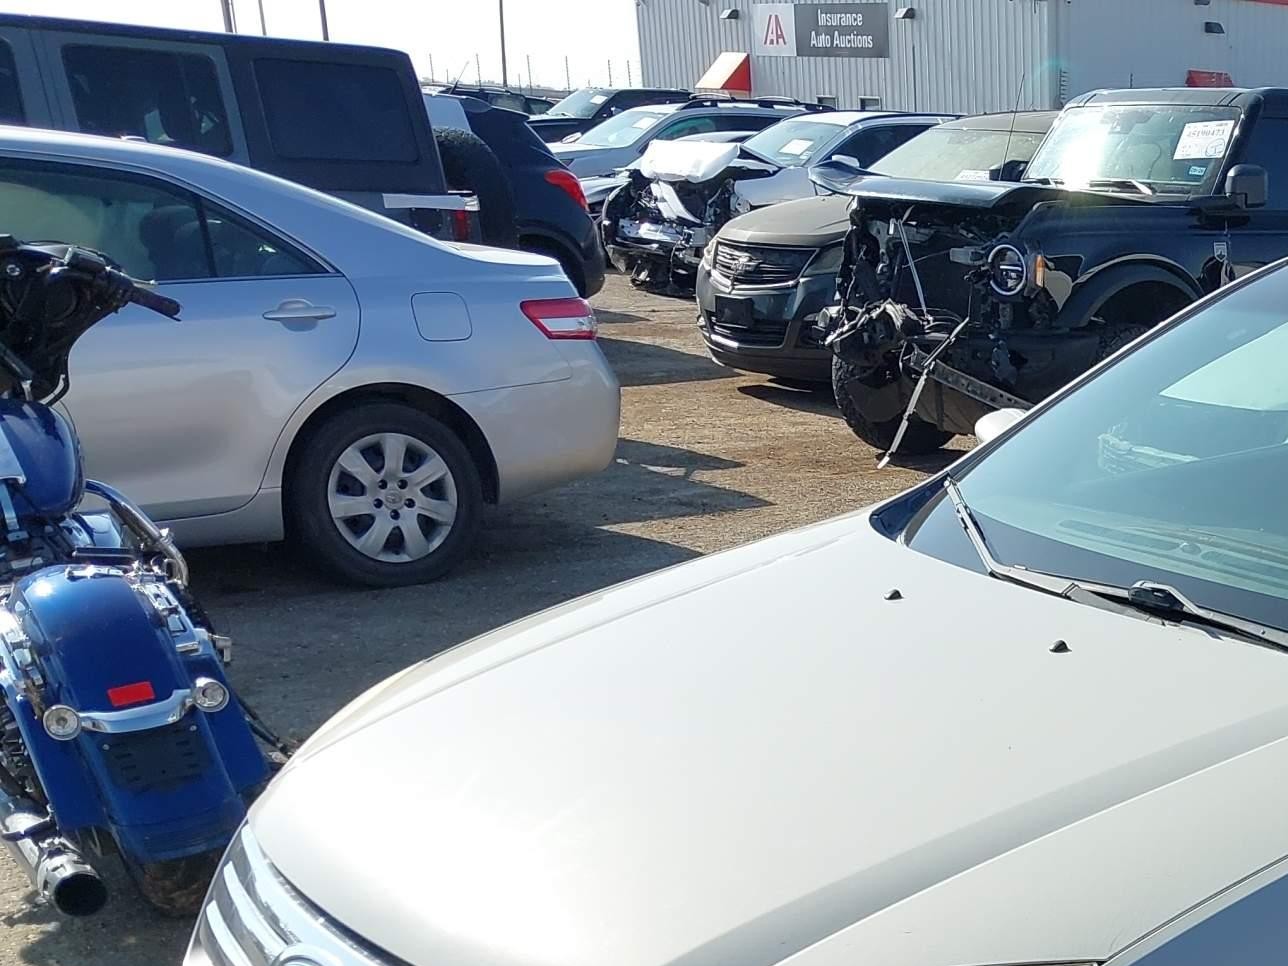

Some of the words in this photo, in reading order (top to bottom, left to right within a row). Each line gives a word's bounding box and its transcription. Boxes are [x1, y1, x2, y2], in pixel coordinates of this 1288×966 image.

[817, 9, 863, 26] Insurance
[810, 30, 831, 48] Auto
[833, 30, 873, 48] Auctions
